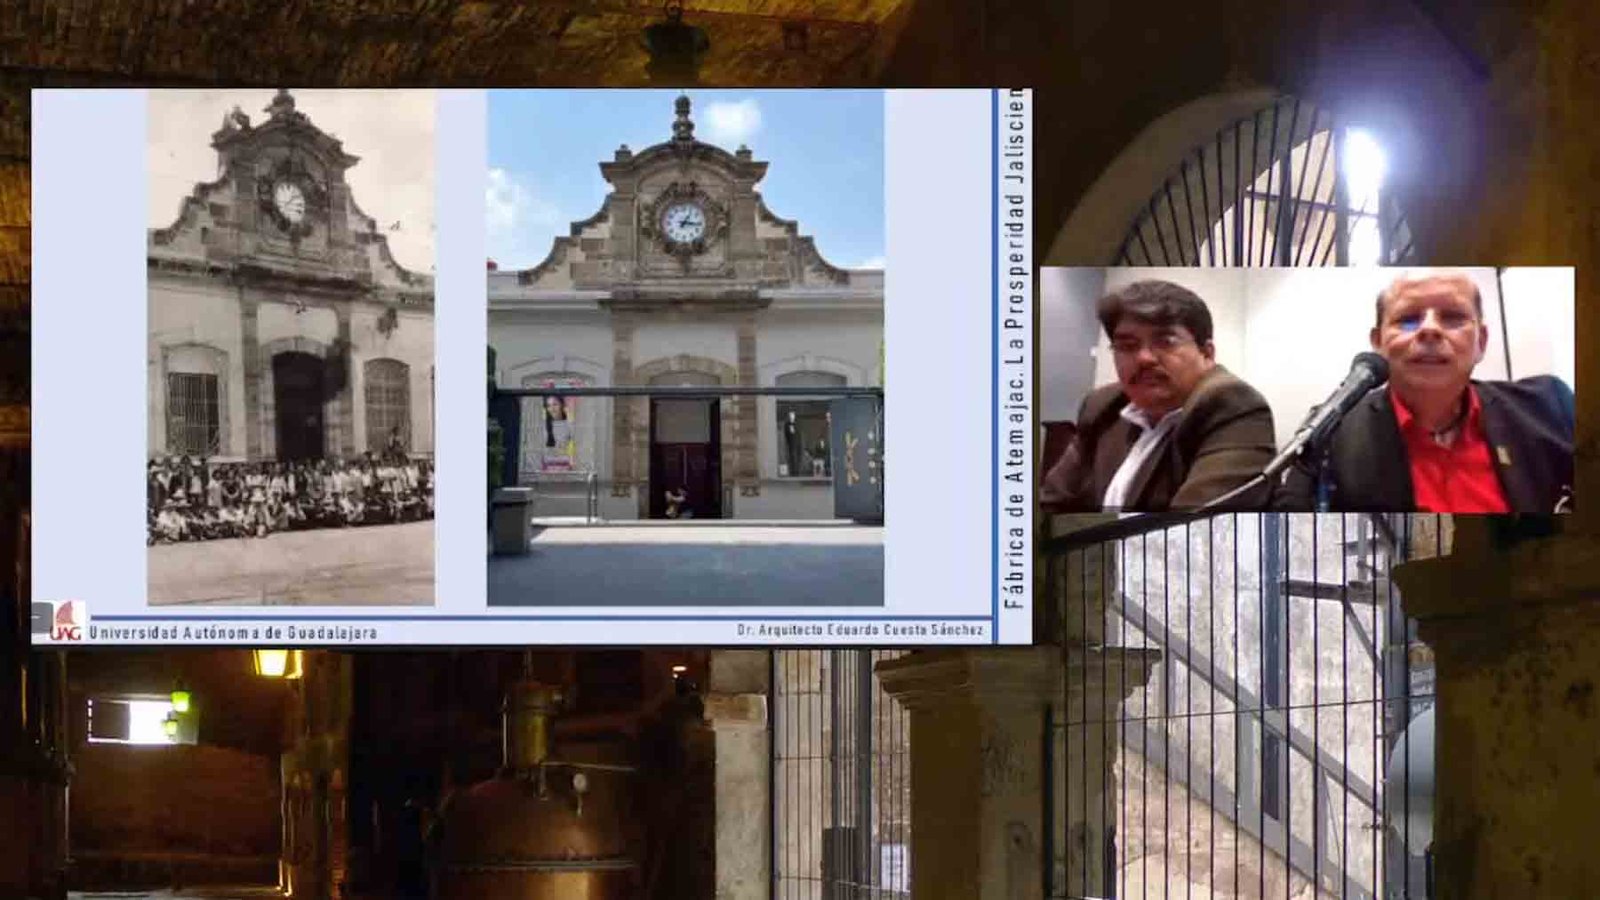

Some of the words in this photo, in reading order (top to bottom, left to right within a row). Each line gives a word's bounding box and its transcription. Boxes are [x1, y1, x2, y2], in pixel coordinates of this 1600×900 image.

[1004, 88, 1024, 183] Jaliscien
[1004, 196, 1028, 328] Prosperidad
[1004, 340, 1024, 364] La
[1004, 373, 1028, 482] Atemajac.
[1004, 495, 1024, 518] de
[1003, 528, 1024, 609] Fábrica
[50, 625, 82, 641] UAG
[89, 625, 178, 640] Universidad
[183, 625, 259, 640] Autónoma
[265, 625, 282, 640] de
[288, 625, 377, 642] Guadalajara
[737, 623, 754, 636] Dr.
[759, 623, 823, 638] Arquitecto
[827, 623, 879, 636] Eduardo
[883, 623, 927, 636] Cuesta
[931, 622, 983, 636] Sánchez
